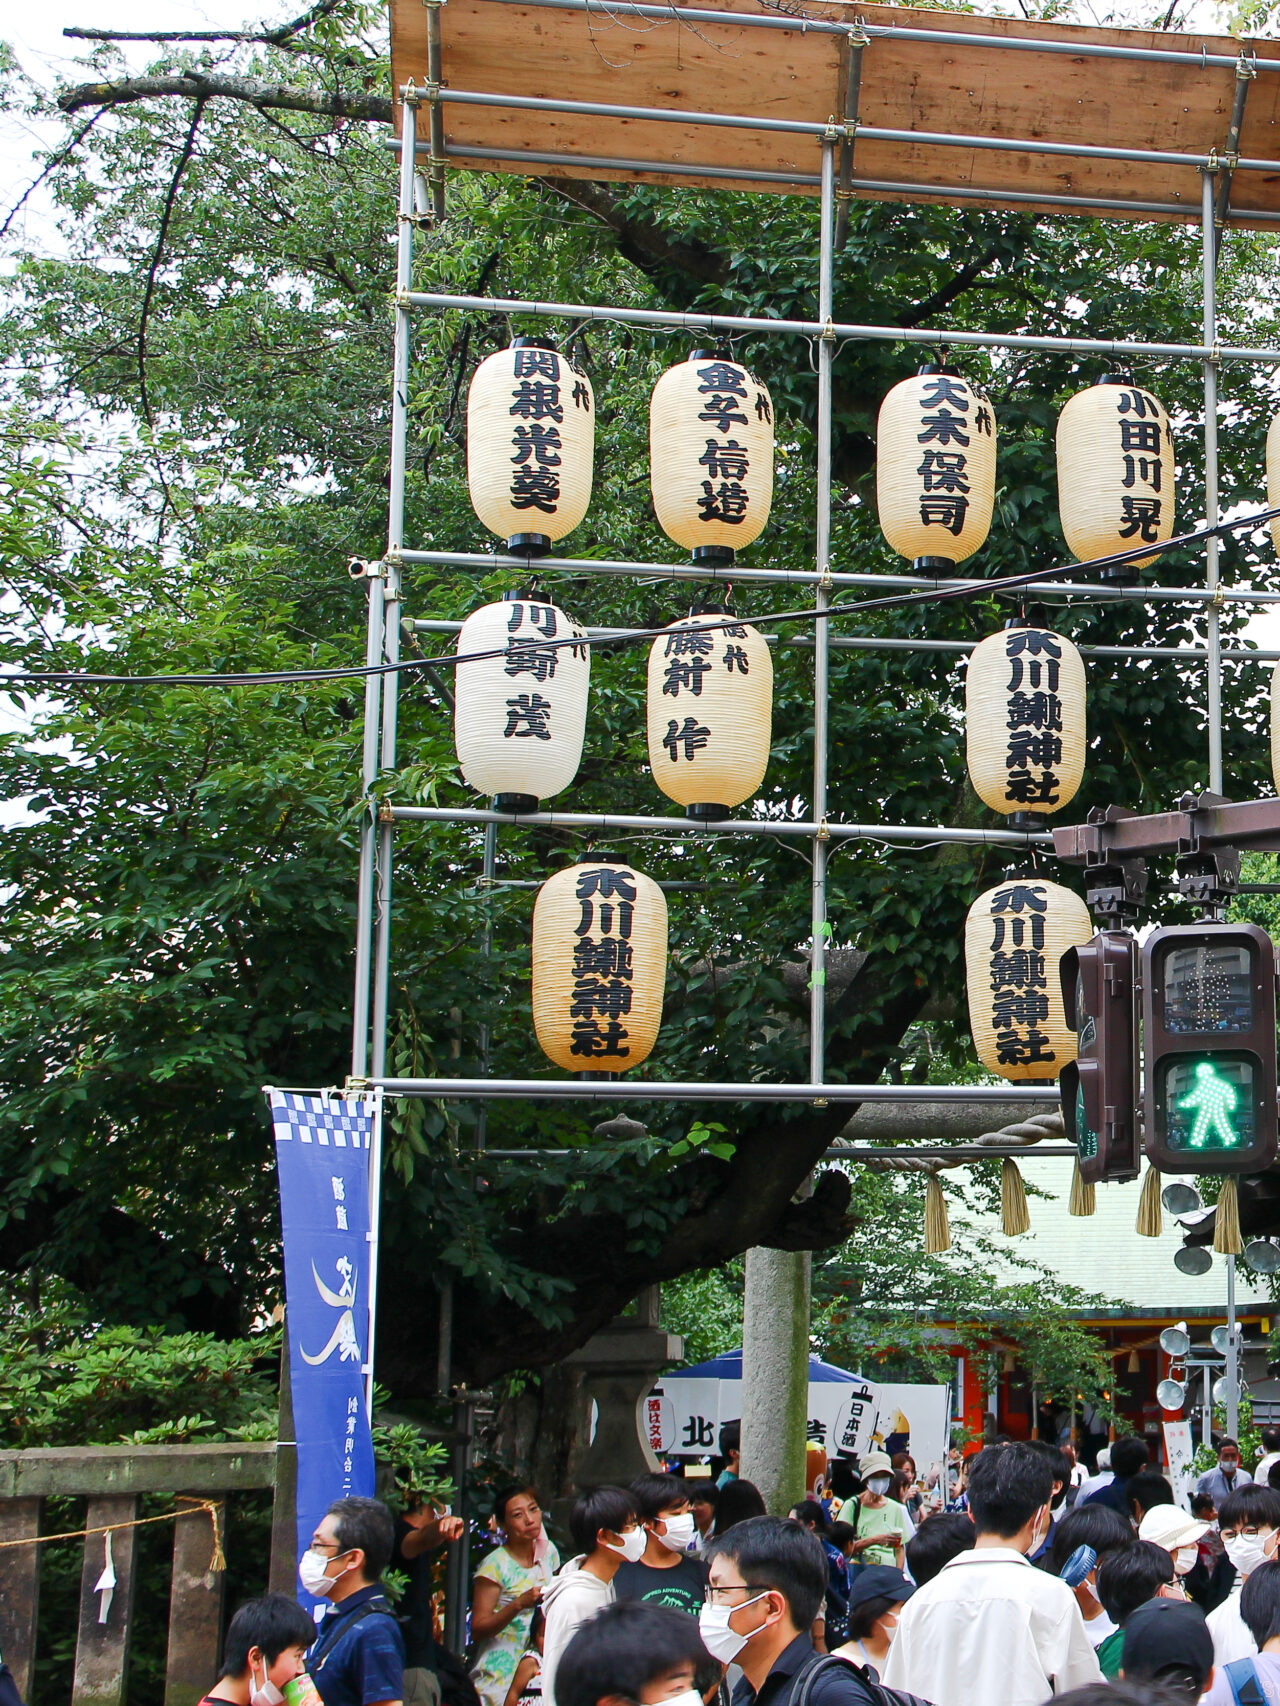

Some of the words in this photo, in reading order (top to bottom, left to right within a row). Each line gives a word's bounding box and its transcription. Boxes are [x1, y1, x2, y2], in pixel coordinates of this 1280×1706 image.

[697, 363, 749, 524] 金子信造
[917, 378, 971, 536] 大木保司
[1117, 389, 1162, 543] 小田川晃
[1005, 630, 1062, 805] 氷川鍬神社
[570, 868, 637, 1057] 氷川鍬神社
[990, 886, 1056, 1066] 氷川鍬神社
[842, 1402, 863, 1447] 日本酒
